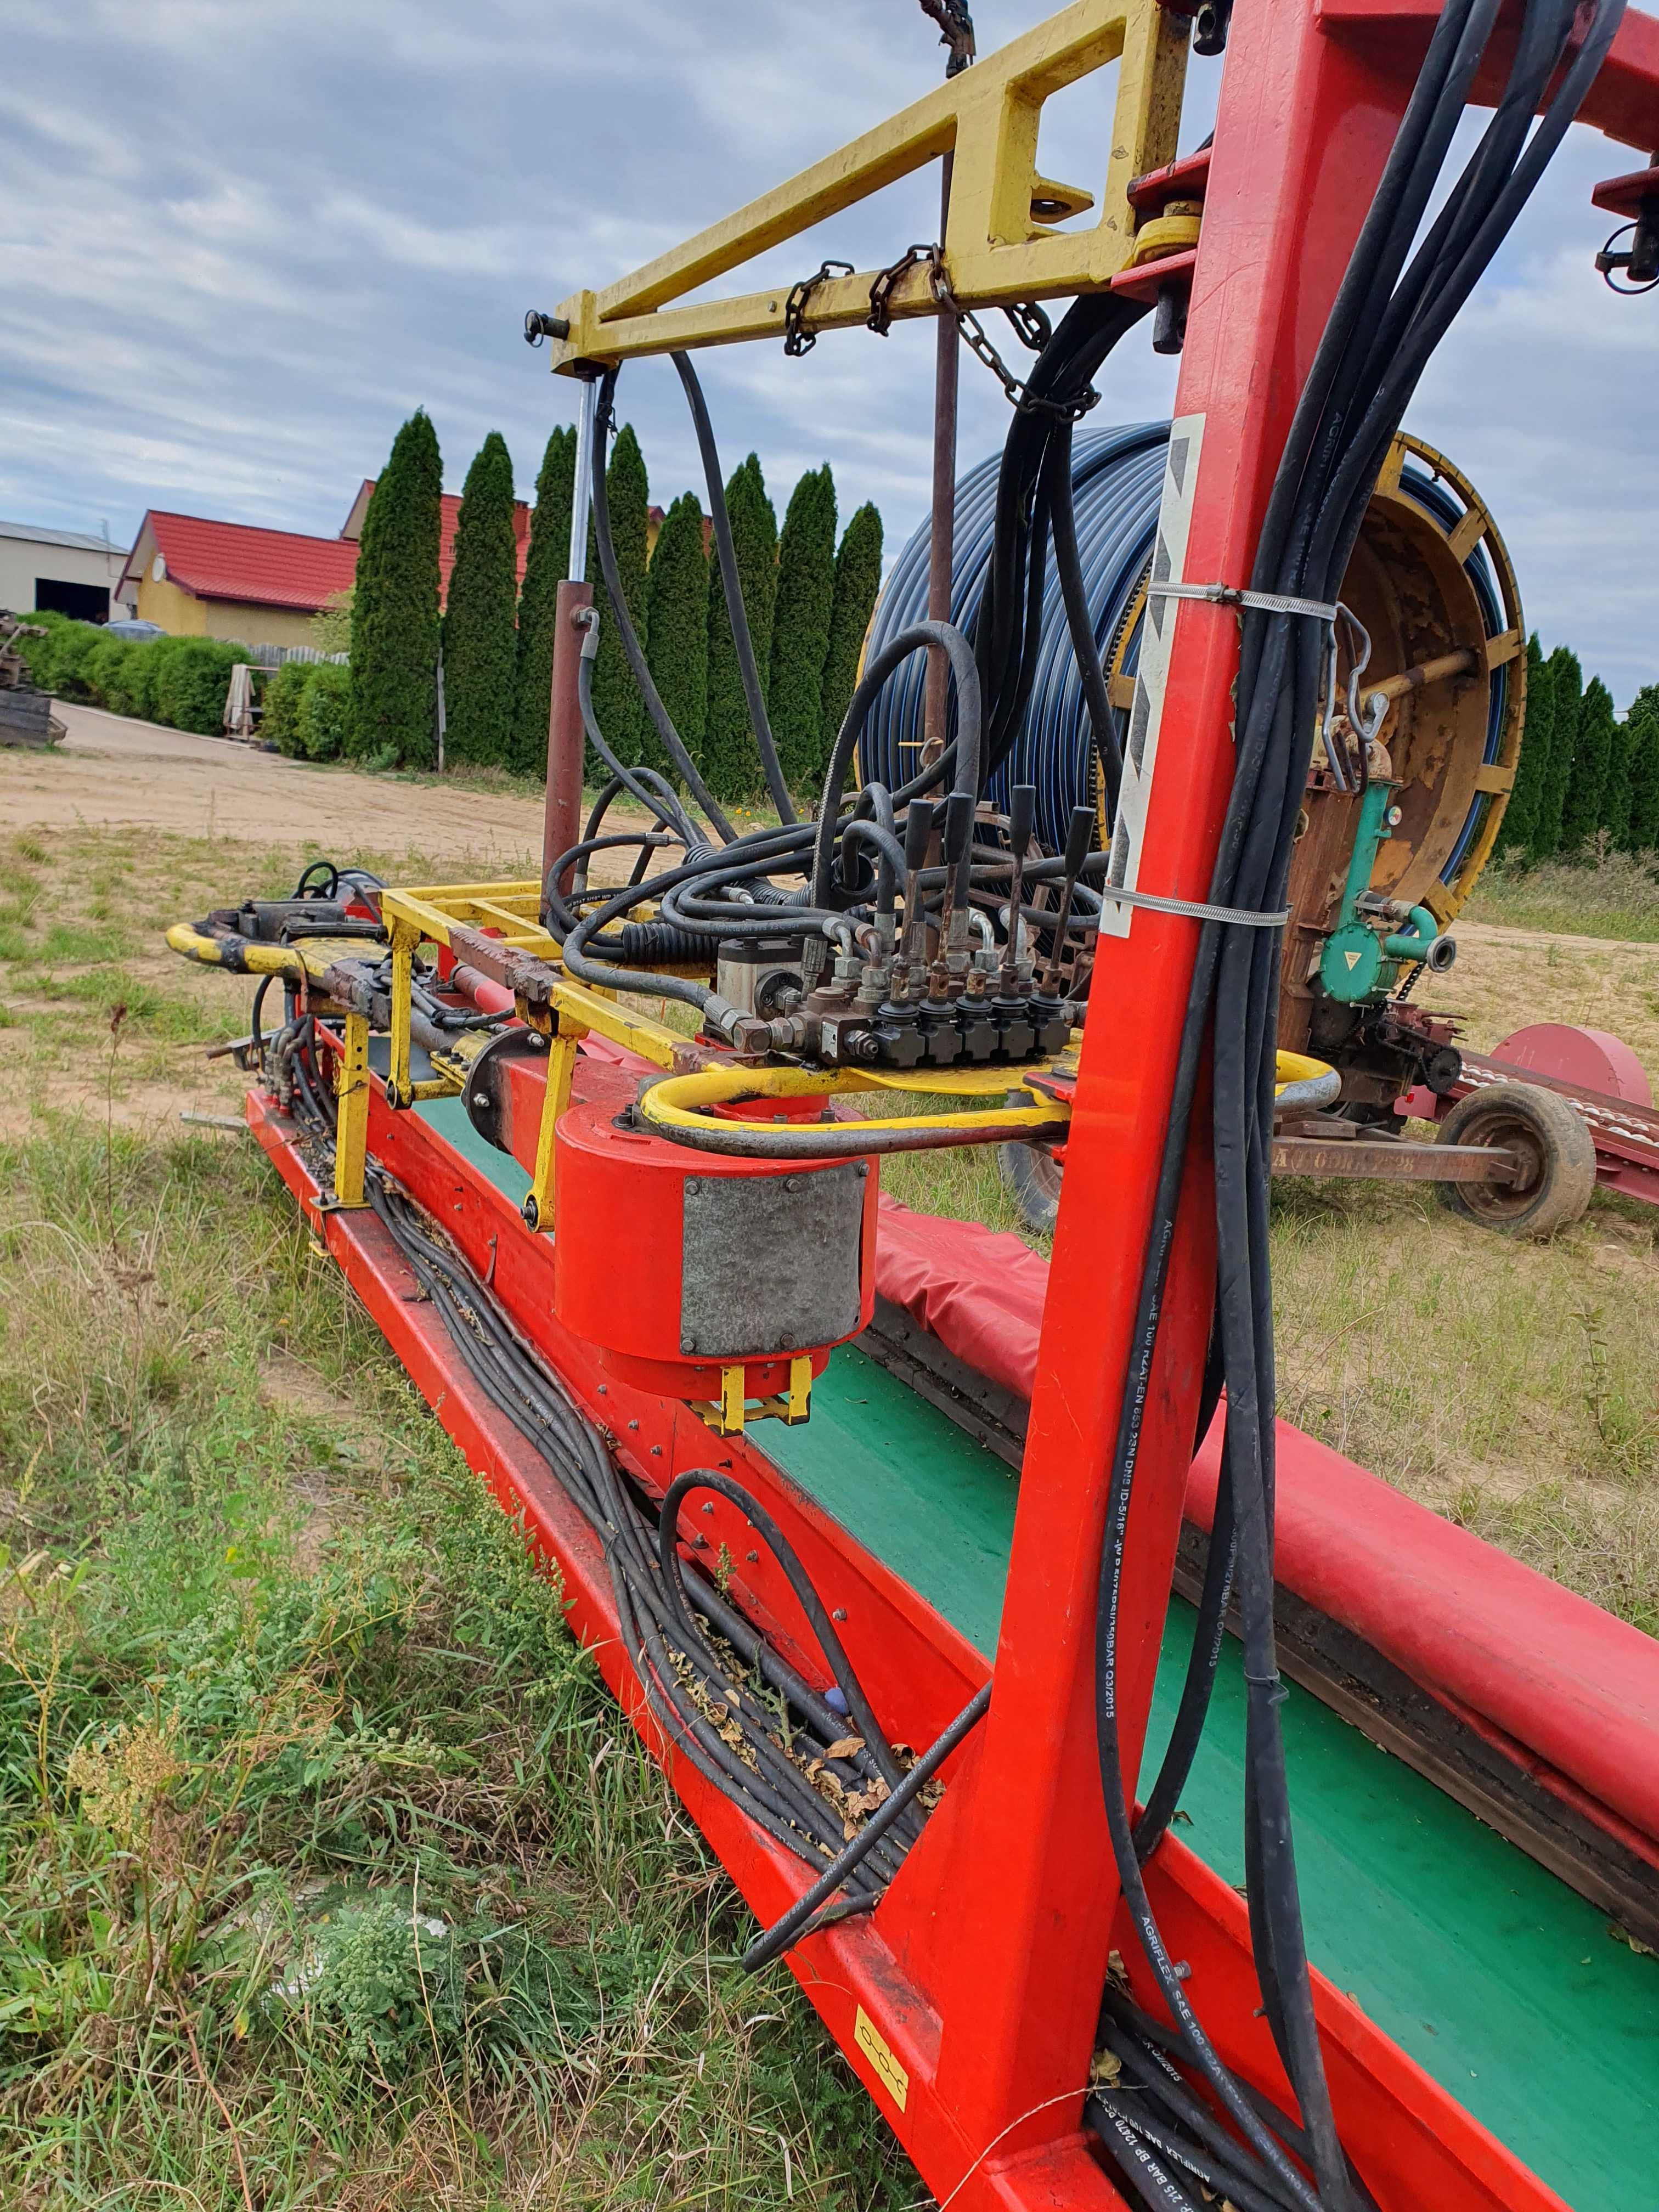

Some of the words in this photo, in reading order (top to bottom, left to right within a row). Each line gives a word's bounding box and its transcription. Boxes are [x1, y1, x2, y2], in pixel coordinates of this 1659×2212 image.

[1154, 1220, 1172, 1286] AGRI
[1145, 1325, 1155, 1346] 100
[1131, 1407, 1142, 1429] 853
[1126, 1432, 1138, 1457] 2SN
[1122, 1460, 1134, 1485] DN8
[687, 1611, 696, 1623] 100
[1105, 1670, 1115, 1719] Q3/2015
[821, 1861, 838, 1883] DN8
[1141, 1916, 1175, 1985] AGRIFLEX
[1175, 1990, 1192, 2021] SAE
[1188, 2022, 1205, 2046] 100
[1115, 2120, 1138, 2146] 12470
[1129, 2118, 1143, 2134] 100
[1135, 2148, 1151, 2163] BP
[1166, 2145, 1210, 2183] AGRIFLEX
[1147, 2162, 1168, 2186] BAR
[1164, 2185, 1183, 2203] 215
